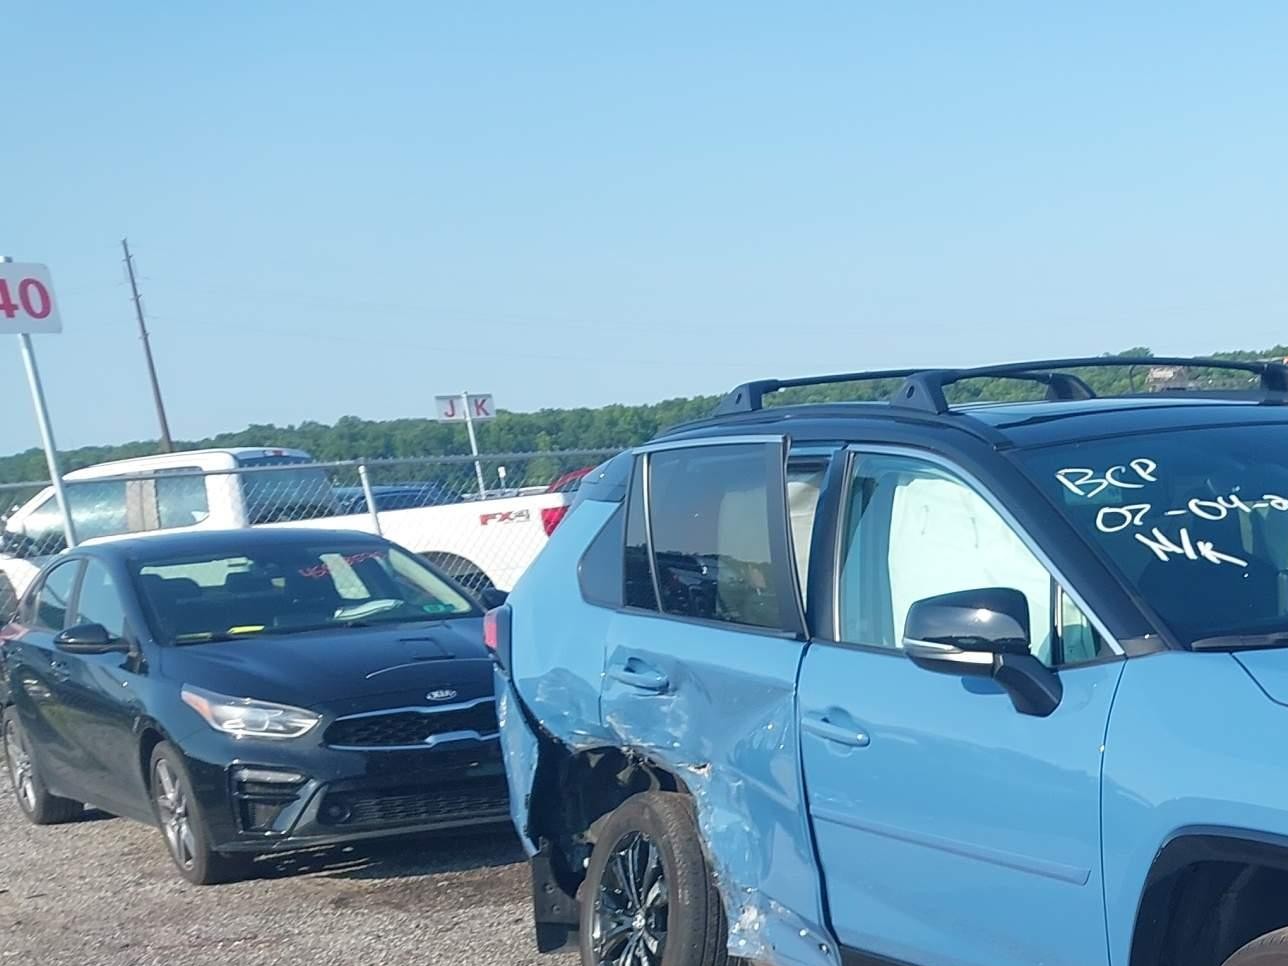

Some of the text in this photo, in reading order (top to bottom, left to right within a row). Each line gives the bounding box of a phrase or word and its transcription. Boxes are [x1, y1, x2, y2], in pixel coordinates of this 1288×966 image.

[444, 398, 490, 418] J K
[1056, 458, 1157, 497] BCP
[480, 509, 530, 525] FX4
